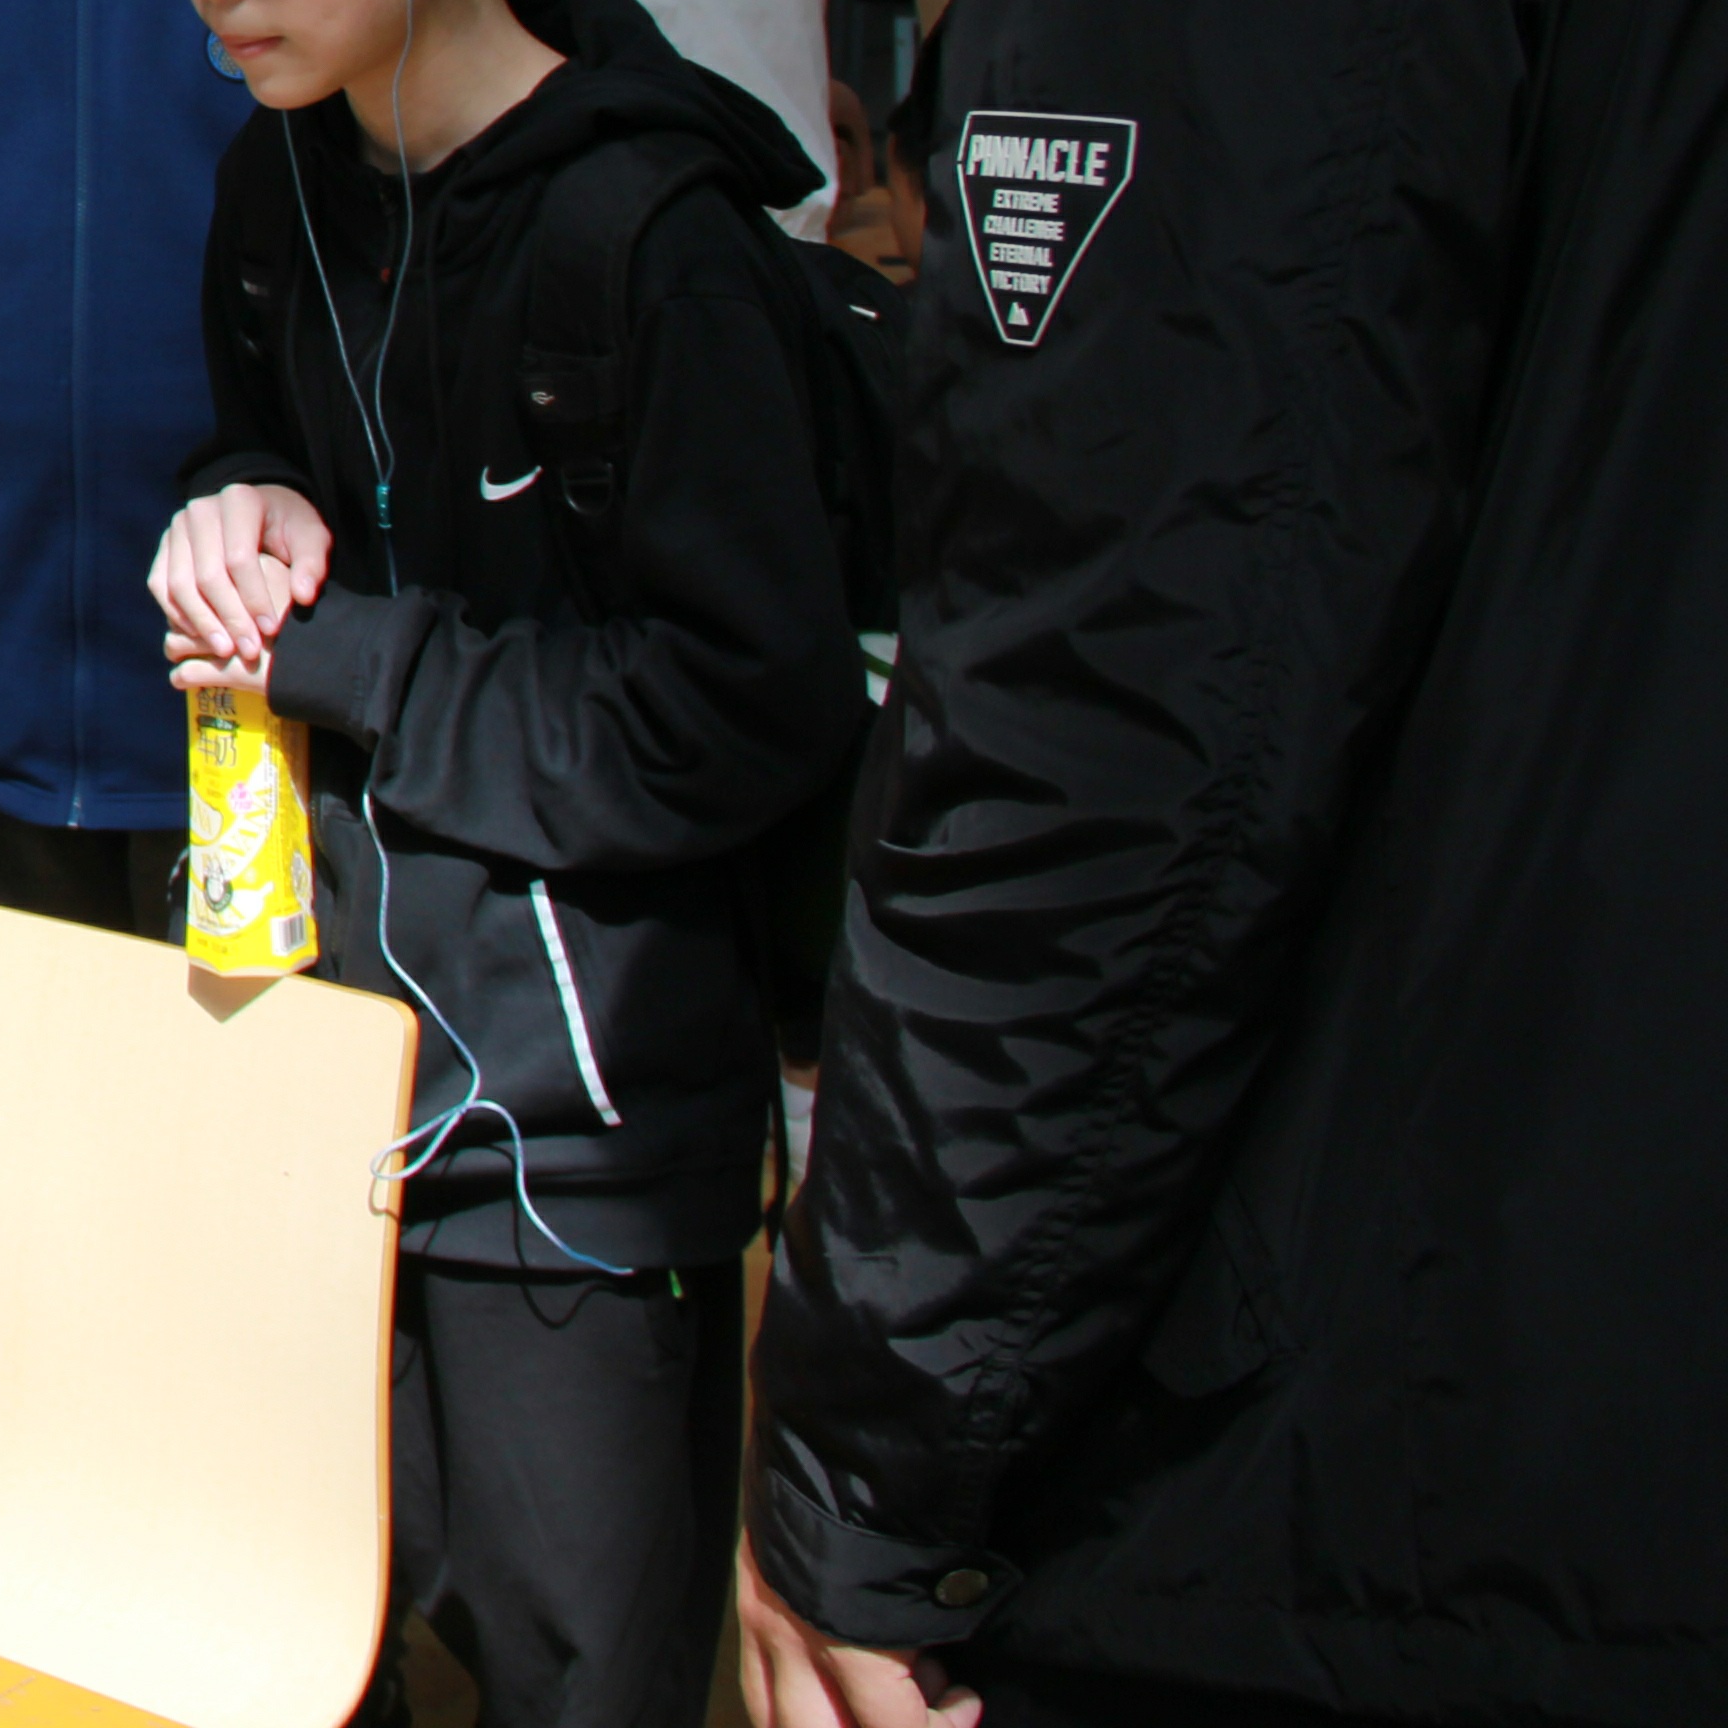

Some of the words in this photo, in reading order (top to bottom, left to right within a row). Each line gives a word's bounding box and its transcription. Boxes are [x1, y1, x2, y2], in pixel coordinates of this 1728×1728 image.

[966, 134, 1111, 186] PINNACLE
[993, 189, 1060, 213] EXTREME
[983, 215, 1065, 241] CHALLENGE
[989, 242, 1053, 267] ETERNAL
[990, 270, 1052, 295] VICTORY
